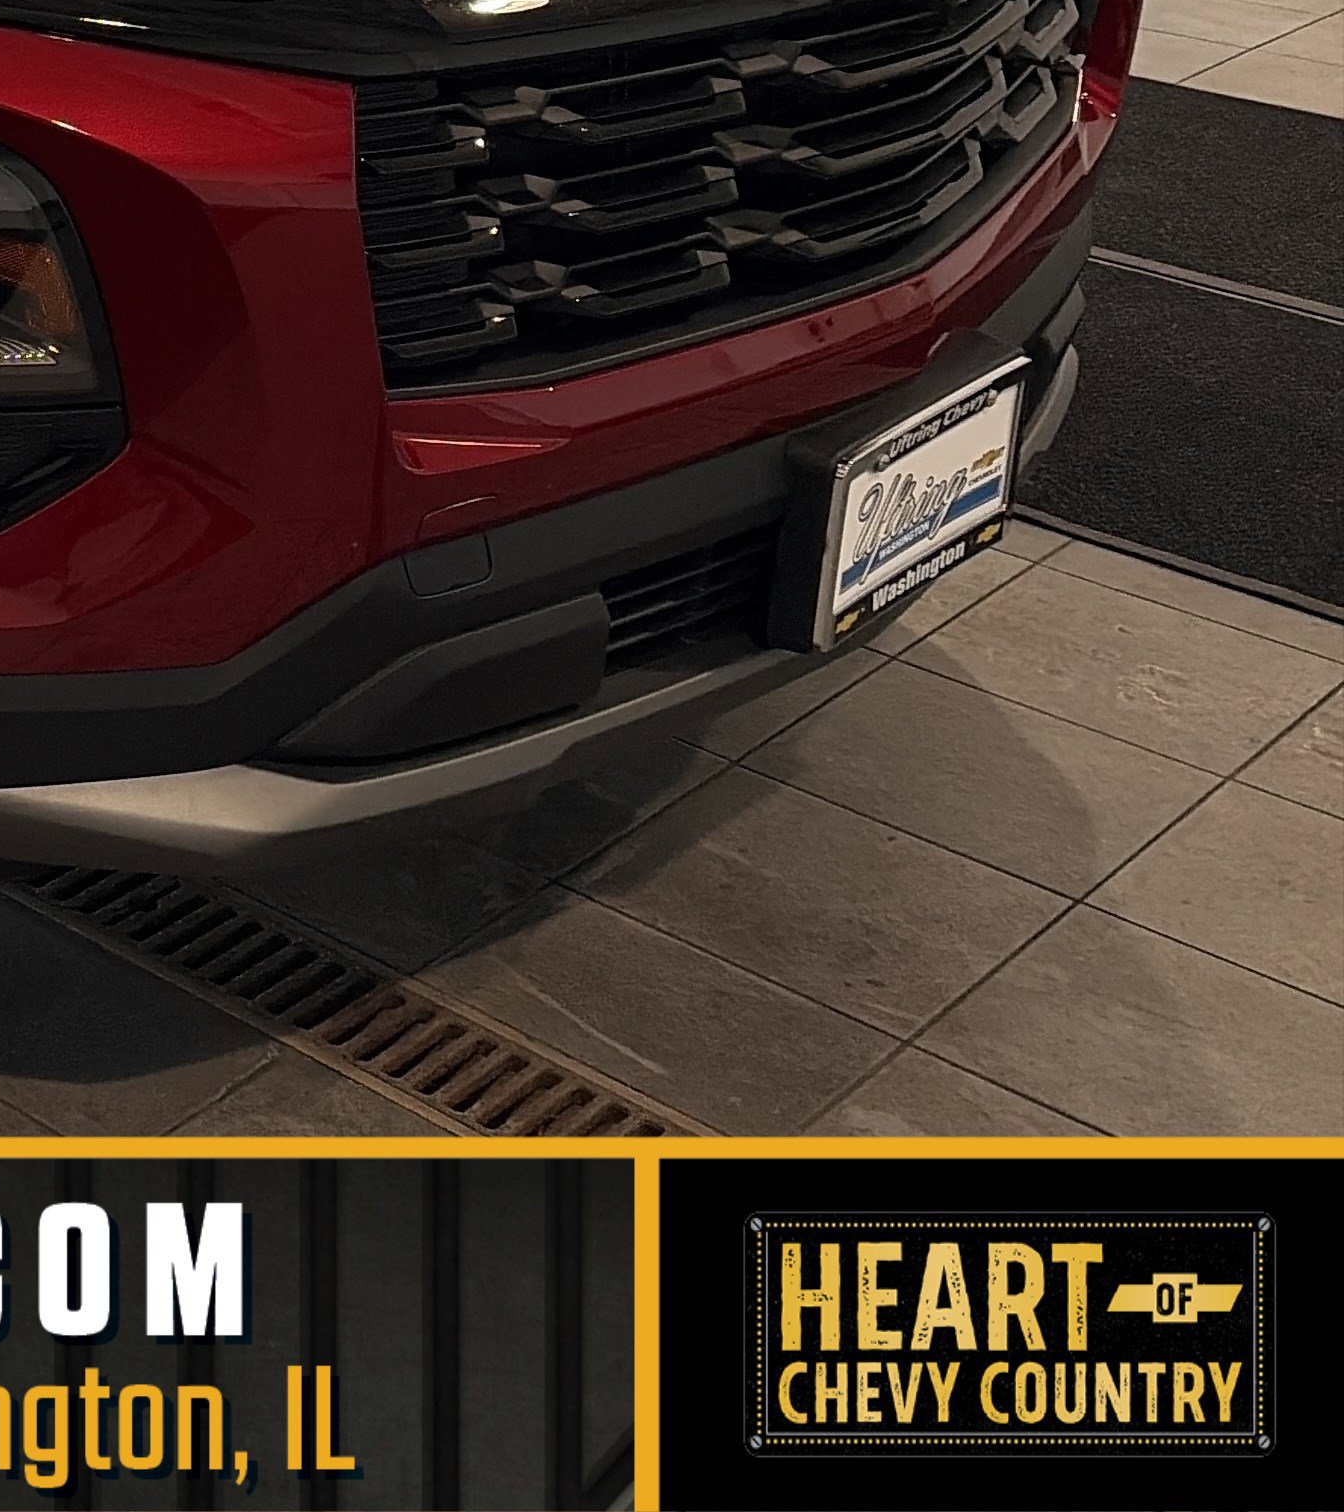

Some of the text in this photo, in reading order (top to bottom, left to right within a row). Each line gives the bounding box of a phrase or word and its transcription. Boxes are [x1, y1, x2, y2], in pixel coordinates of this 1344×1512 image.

[889, 390, 988, 459] Uftring Chevy
[852, 467, 968, 585] Uftring
[878, 521, 931, 561] WASHINGTON
[872, 541, 966, 612] Washington
